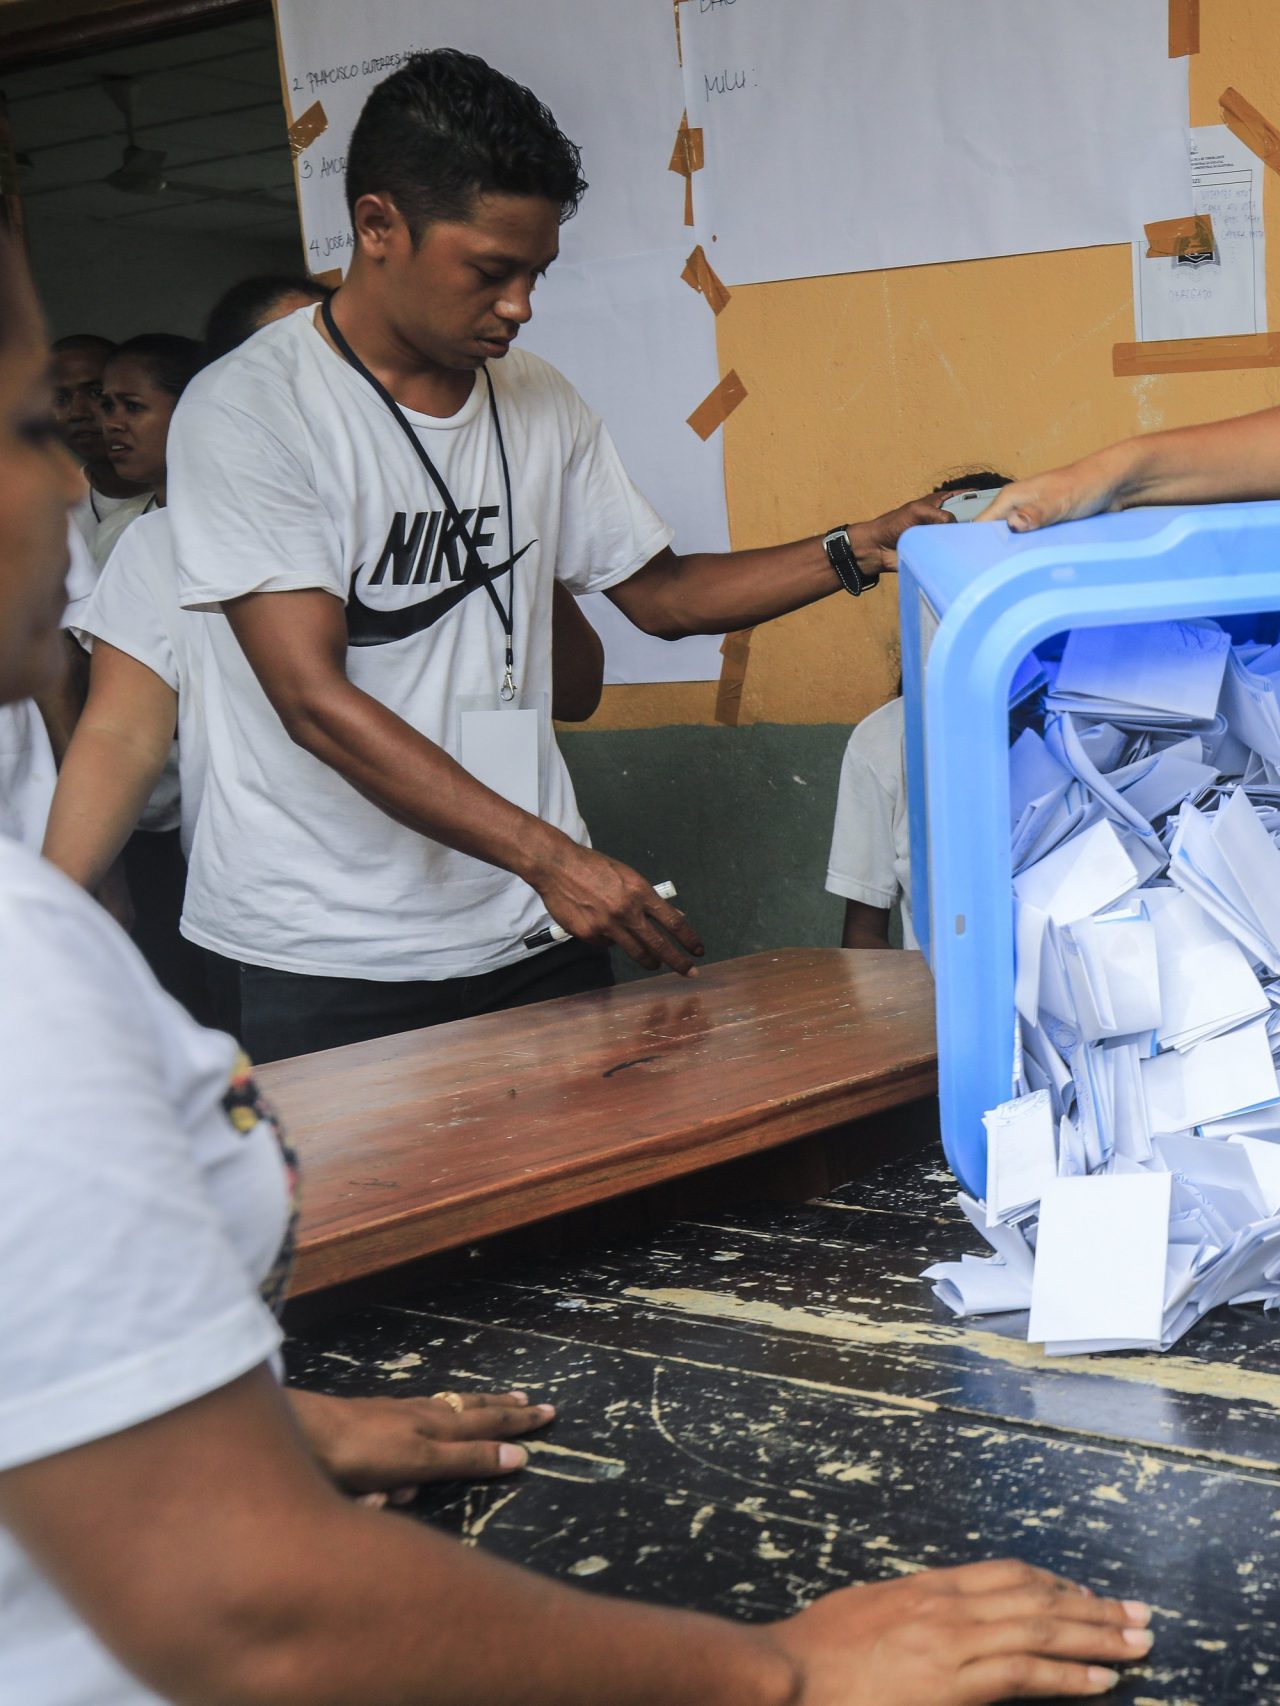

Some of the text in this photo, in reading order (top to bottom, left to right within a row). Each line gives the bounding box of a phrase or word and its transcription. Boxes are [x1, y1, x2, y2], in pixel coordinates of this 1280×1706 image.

[301, 160, 313, 179] 3
[309, 239, 320, 257] 4
[368, 505, 501, 586] NIKE
